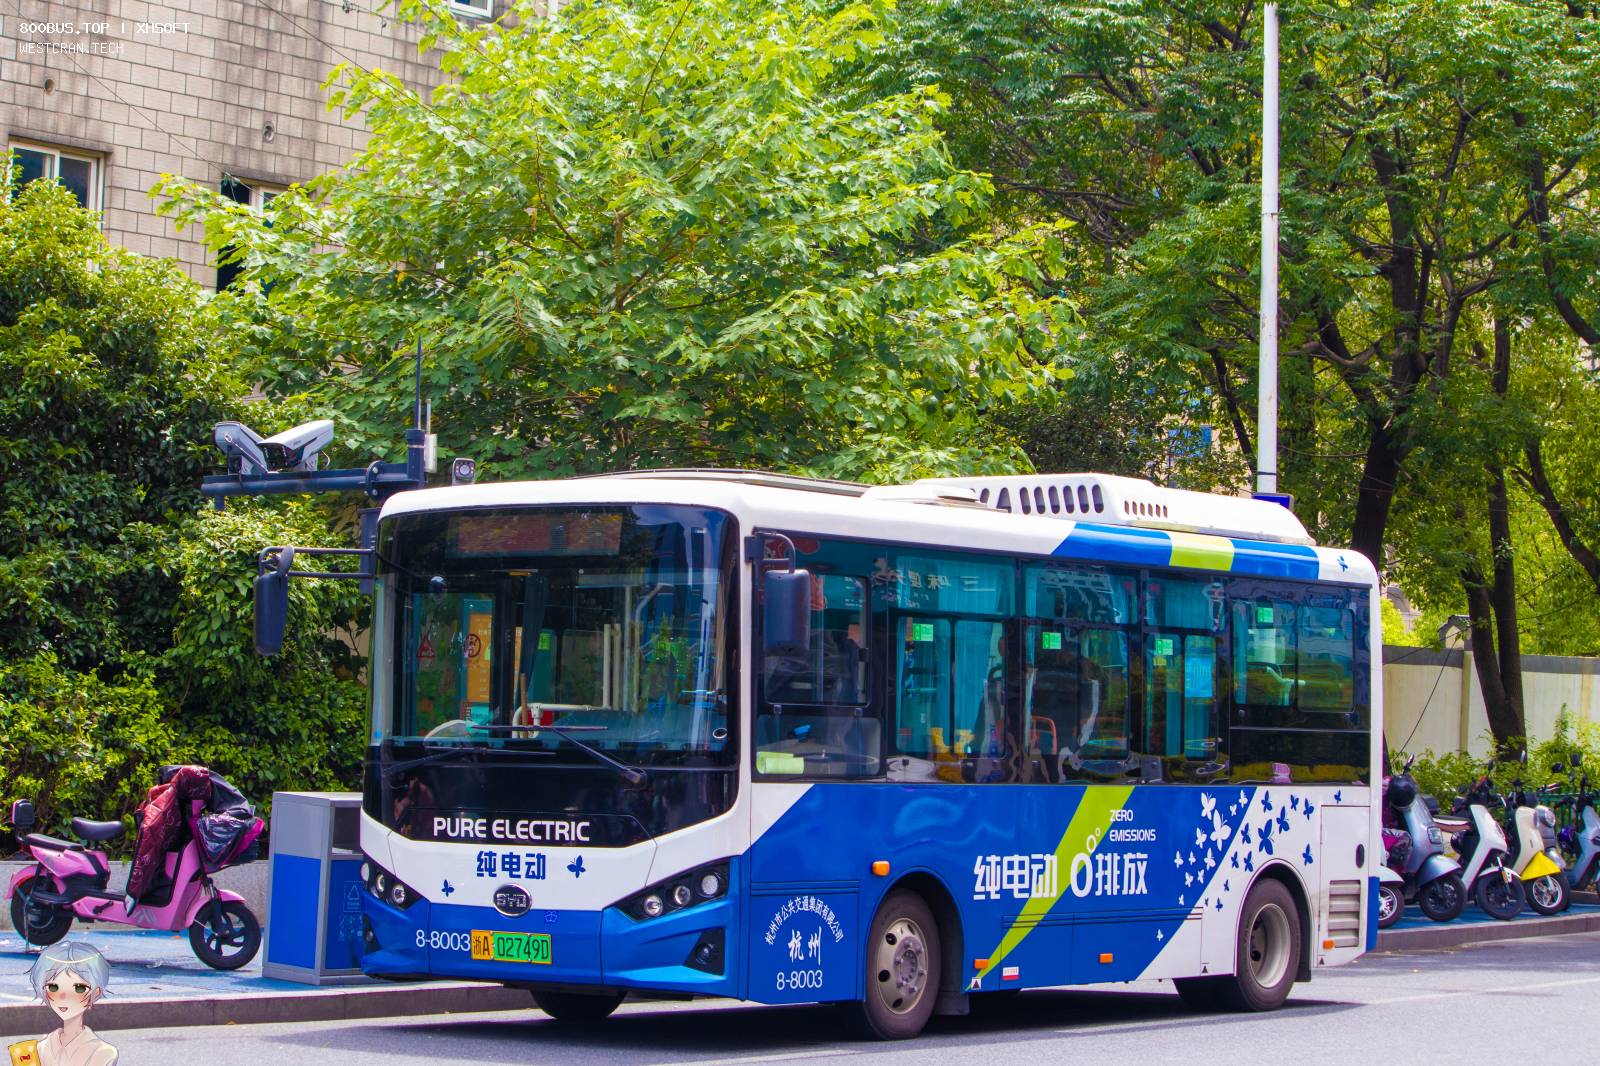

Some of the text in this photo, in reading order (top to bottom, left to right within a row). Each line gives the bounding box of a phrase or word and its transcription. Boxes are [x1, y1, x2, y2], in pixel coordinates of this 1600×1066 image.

[1109, 809, 1134, 822] ZERO
[433, 817, 590, 842] PURE ELECTRIC
[1109, 828, 1156, 842] EMISSIONS
[476, 850, 546, 880] 纯电动
[973, 853, 1058, 901] 纯电动
[496, 893, 527, 908] BYD
[764, 895, 844, 946] 杭州市公共交通集团有限公司
[415, 929, 471, 952] 8-8003
[787, 925, 822, 967] 杭州
[776, 969, 823, 991] 8-8003
